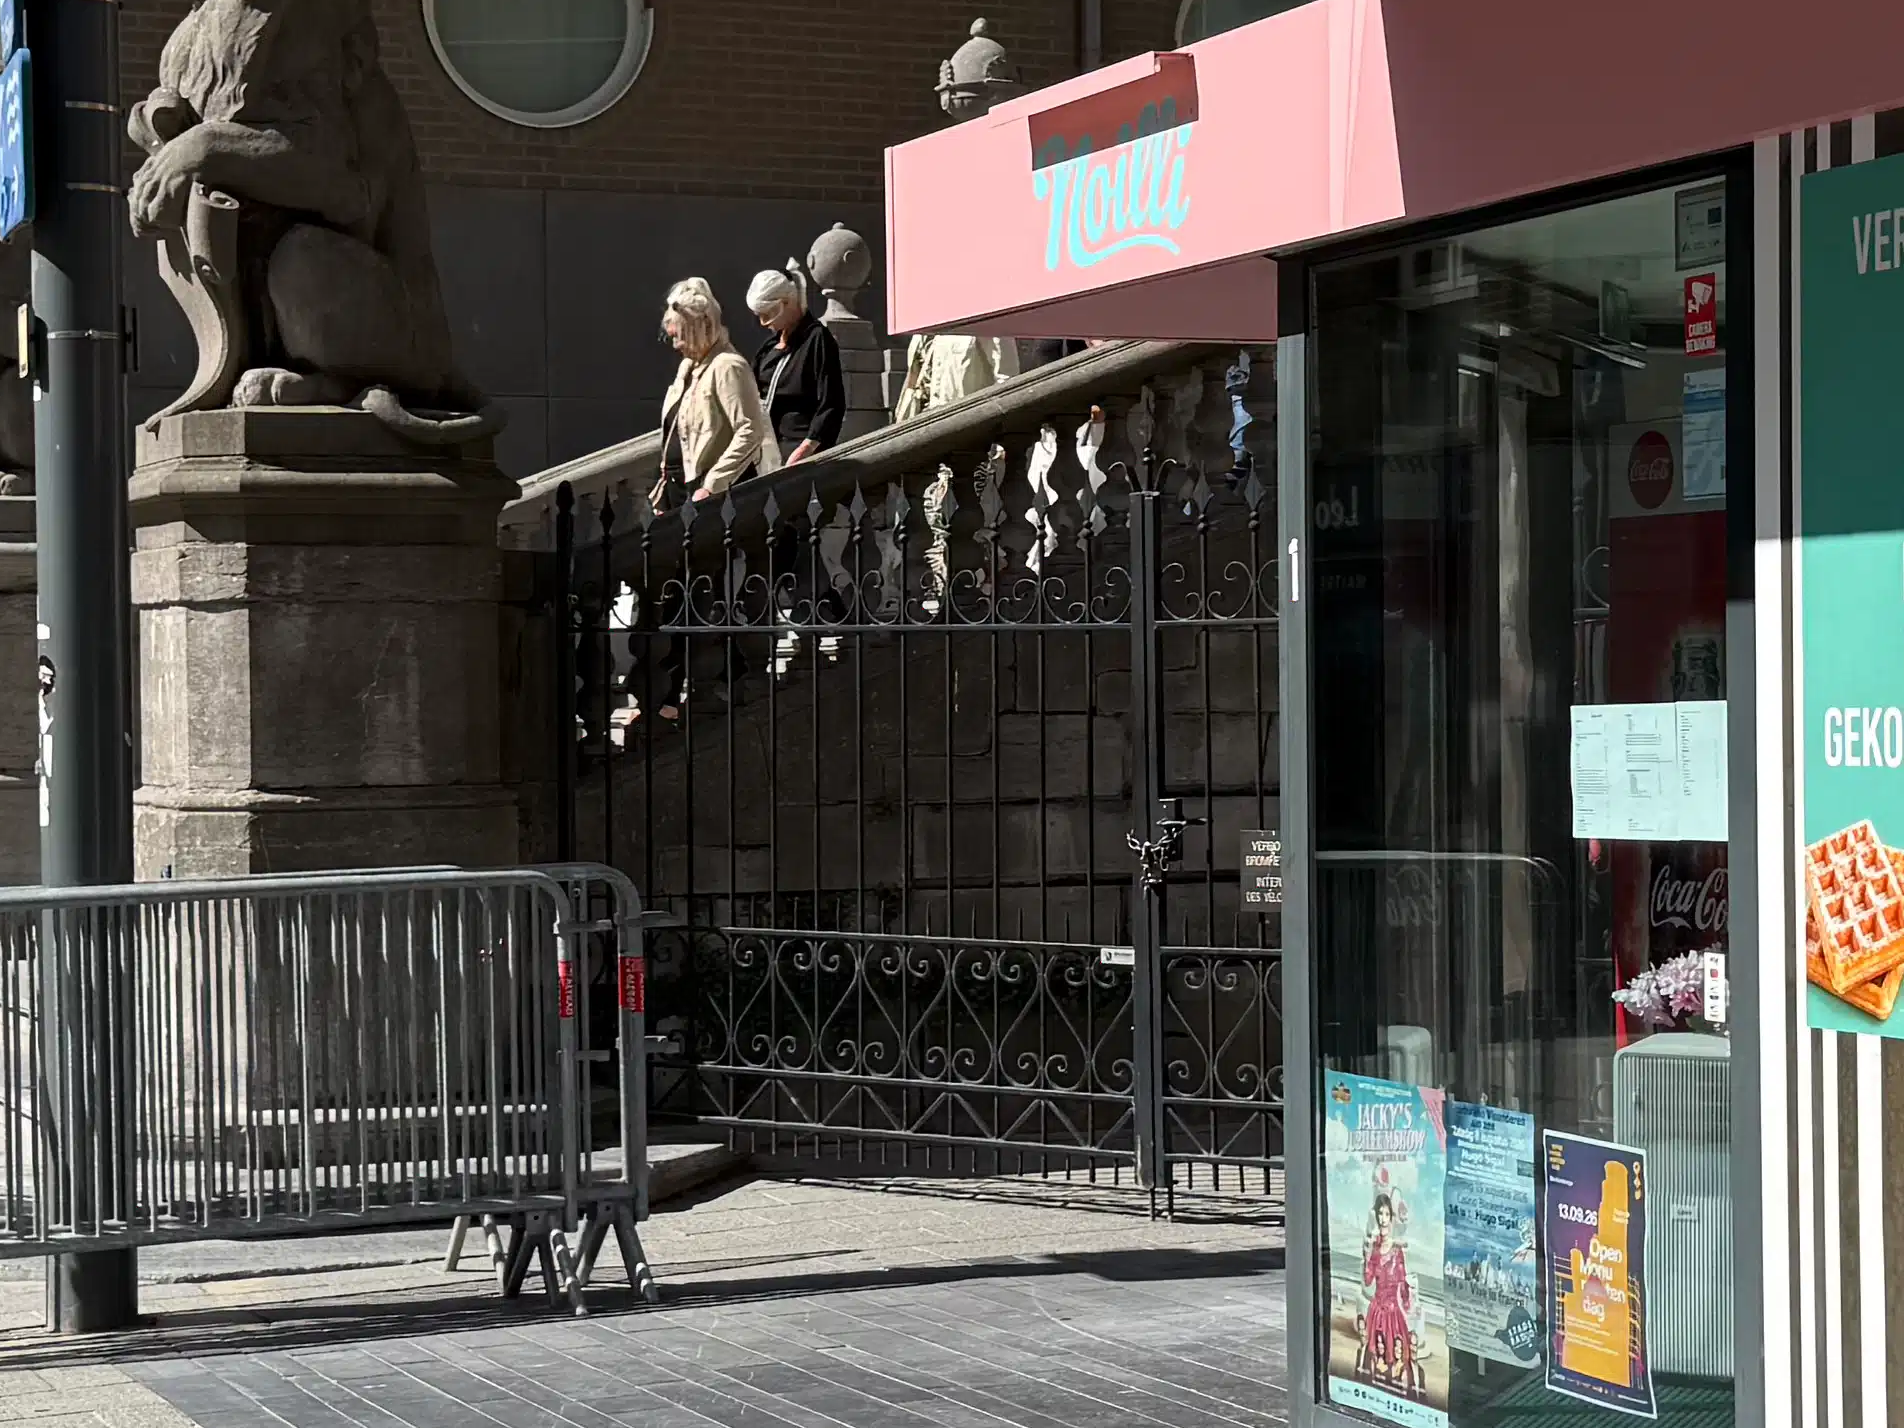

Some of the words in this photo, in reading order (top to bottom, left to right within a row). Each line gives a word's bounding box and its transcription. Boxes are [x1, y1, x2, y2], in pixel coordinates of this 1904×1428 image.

[1034, 96, 1193, 271] Noilli
[1357, 1102, 1413, 1131] JACKY'S
[1590, 1237, 1623, 1264] Open
[1583, 1295, 1605, 1323] dag
